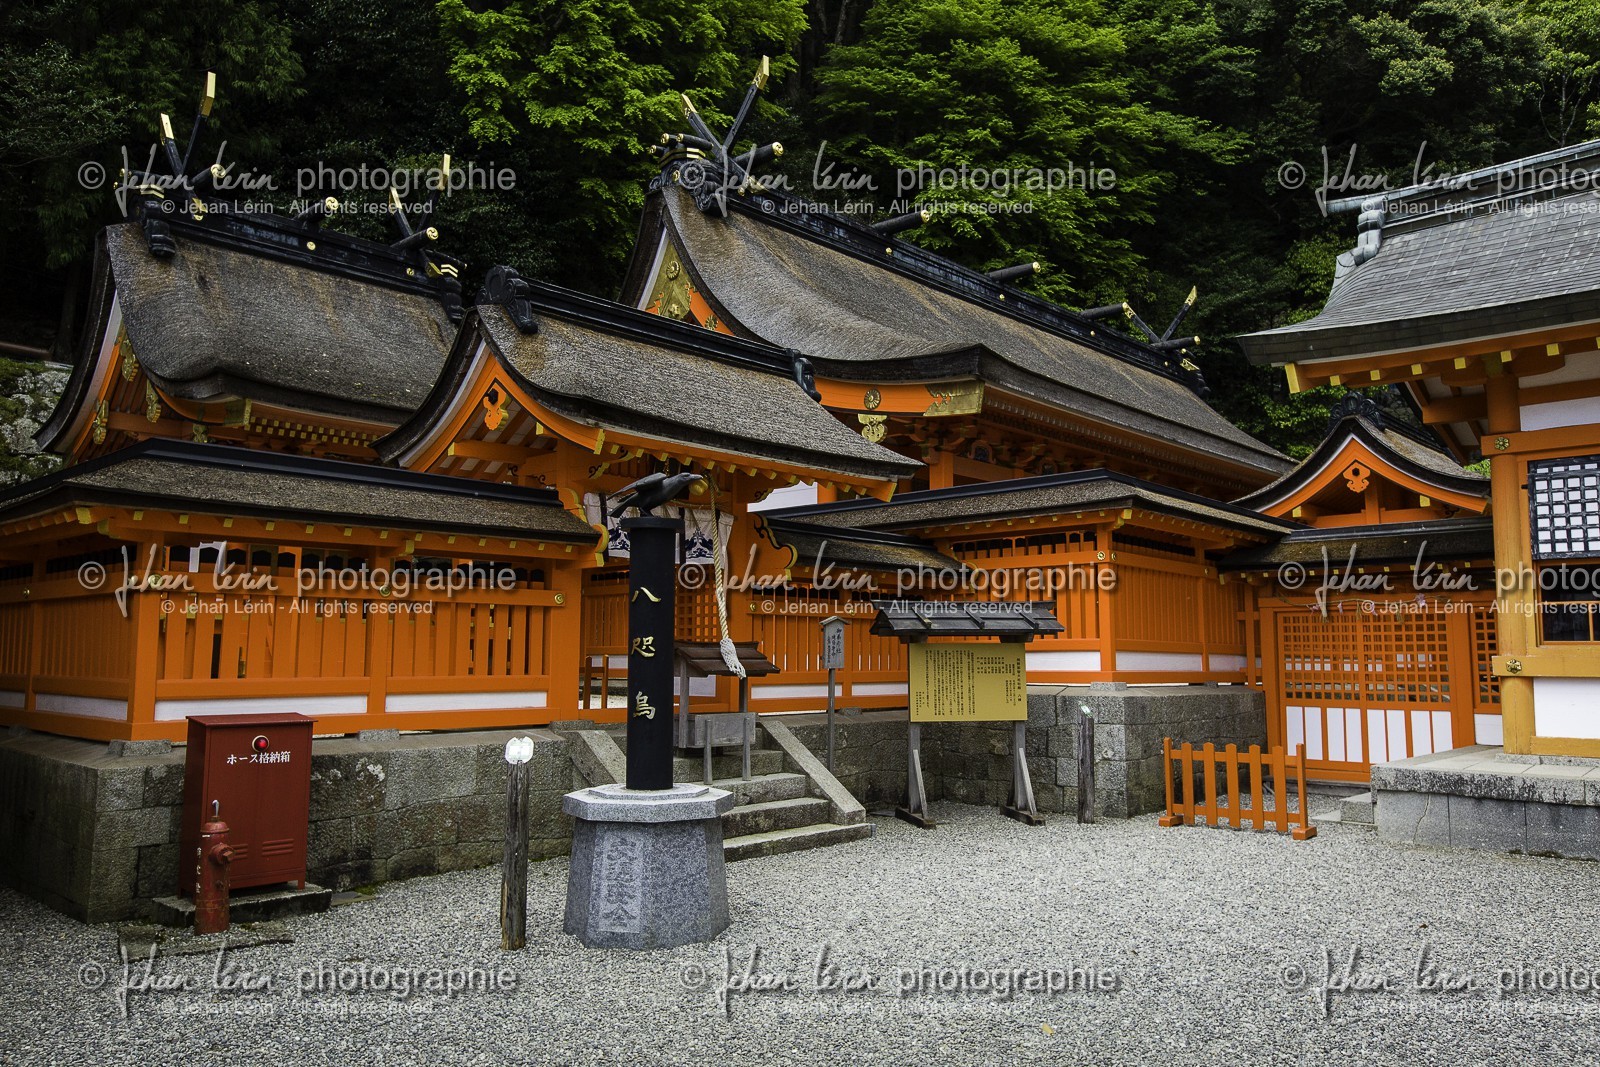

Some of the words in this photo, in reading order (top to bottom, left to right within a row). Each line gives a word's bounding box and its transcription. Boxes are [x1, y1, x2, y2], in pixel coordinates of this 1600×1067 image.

[226, 751, 291, 765] ホース格納箱
